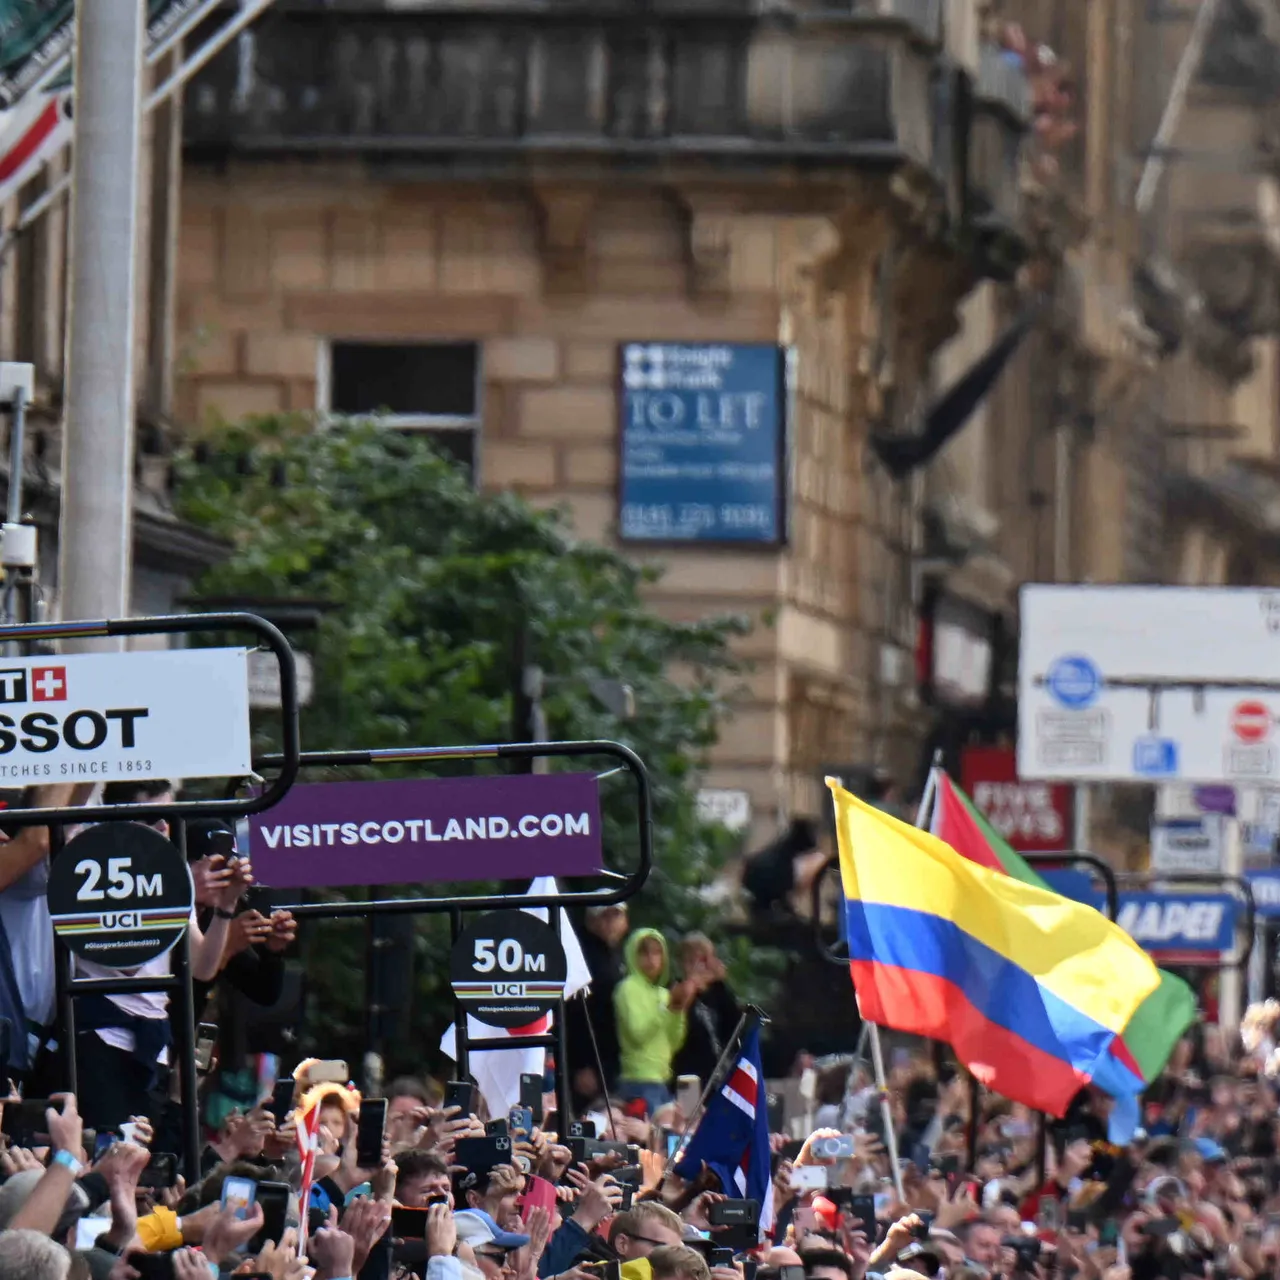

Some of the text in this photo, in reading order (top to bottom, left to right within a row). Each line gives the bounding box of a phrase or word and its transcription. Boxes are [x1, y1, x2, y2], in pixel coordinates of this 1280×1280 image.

[60, 761, 108, 775] SINCE
[118, 759, 152, 772] 1853
[259, 812, 590, 849] VISITSCOTLAND.COM
[74, 857, 163, 900] 25M
[101, 912, 138, 929] UCI
[471, 938, 546, 973] 50M
[494, 984, 523, 996] UCI
